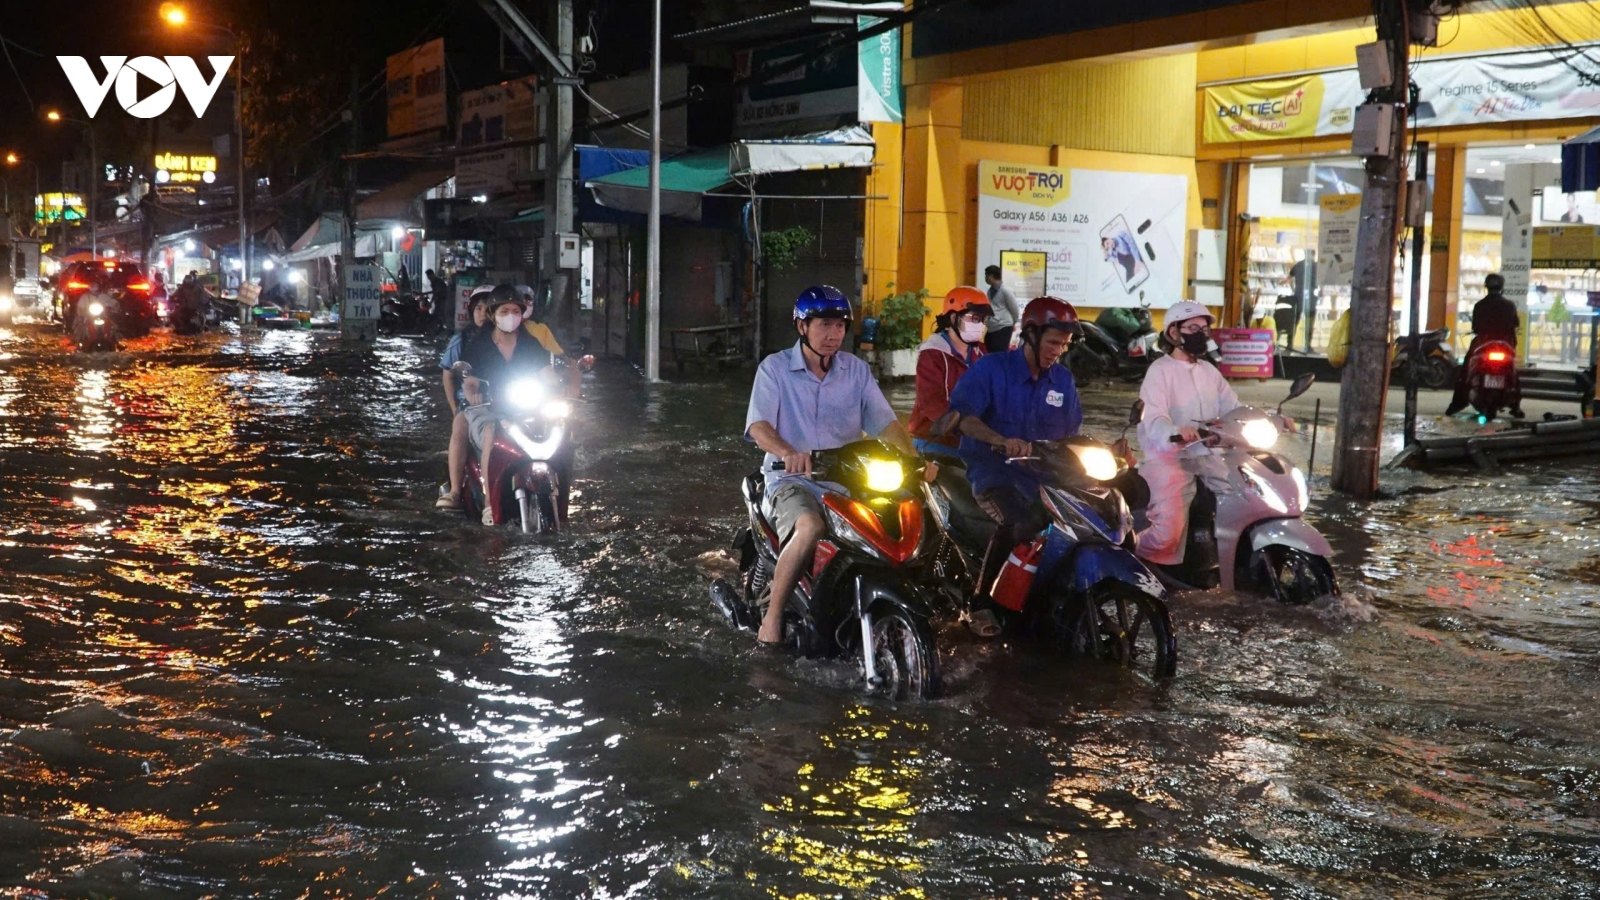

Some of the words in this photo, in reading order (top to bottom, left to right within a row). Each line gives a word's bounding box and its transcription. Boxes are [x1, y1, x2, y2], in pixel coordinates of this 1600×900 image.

[883, 57, 891, 97] vistra
[1439, 83, 1483, 97] realme
[1487, 80, 1498, 93] 15
[1500, 80, 1537, 92] Series
[1247, 98, 1282, 116] TIỆC
[998, 166, 1027, 174] SAMSUNG
[1029, 170, 1063, 193] TRỘI
[993, 209, 1027, 224] Galaxy
[1029, 211, 1045, 222] A56
[1051, 212, 1067, 223] A36
[1073, 214, 1089, 224] A26
[353, 268, 373, 282] NHÀ
[353, 303, 372, 317] TÂY
